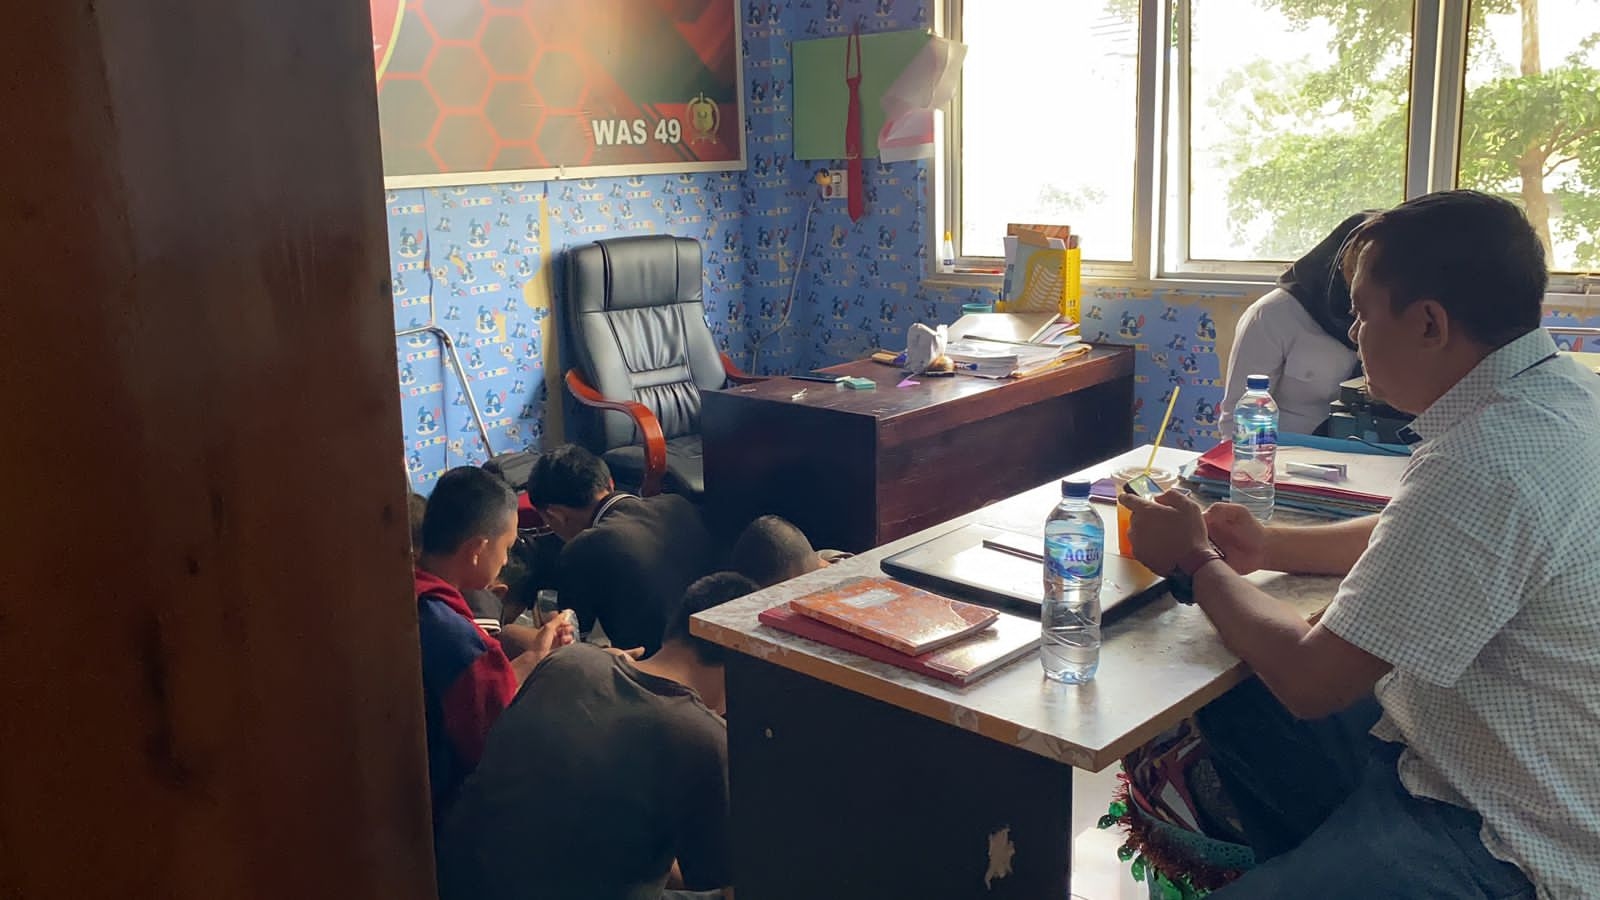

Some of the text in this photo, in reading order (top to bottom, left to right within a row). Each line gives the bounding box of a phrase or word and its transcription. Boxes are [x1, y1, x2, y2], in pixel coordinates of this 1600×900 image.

[592, 118, 681, 145] WAS 49
[1064, 548, 1100, 564] AQUA
